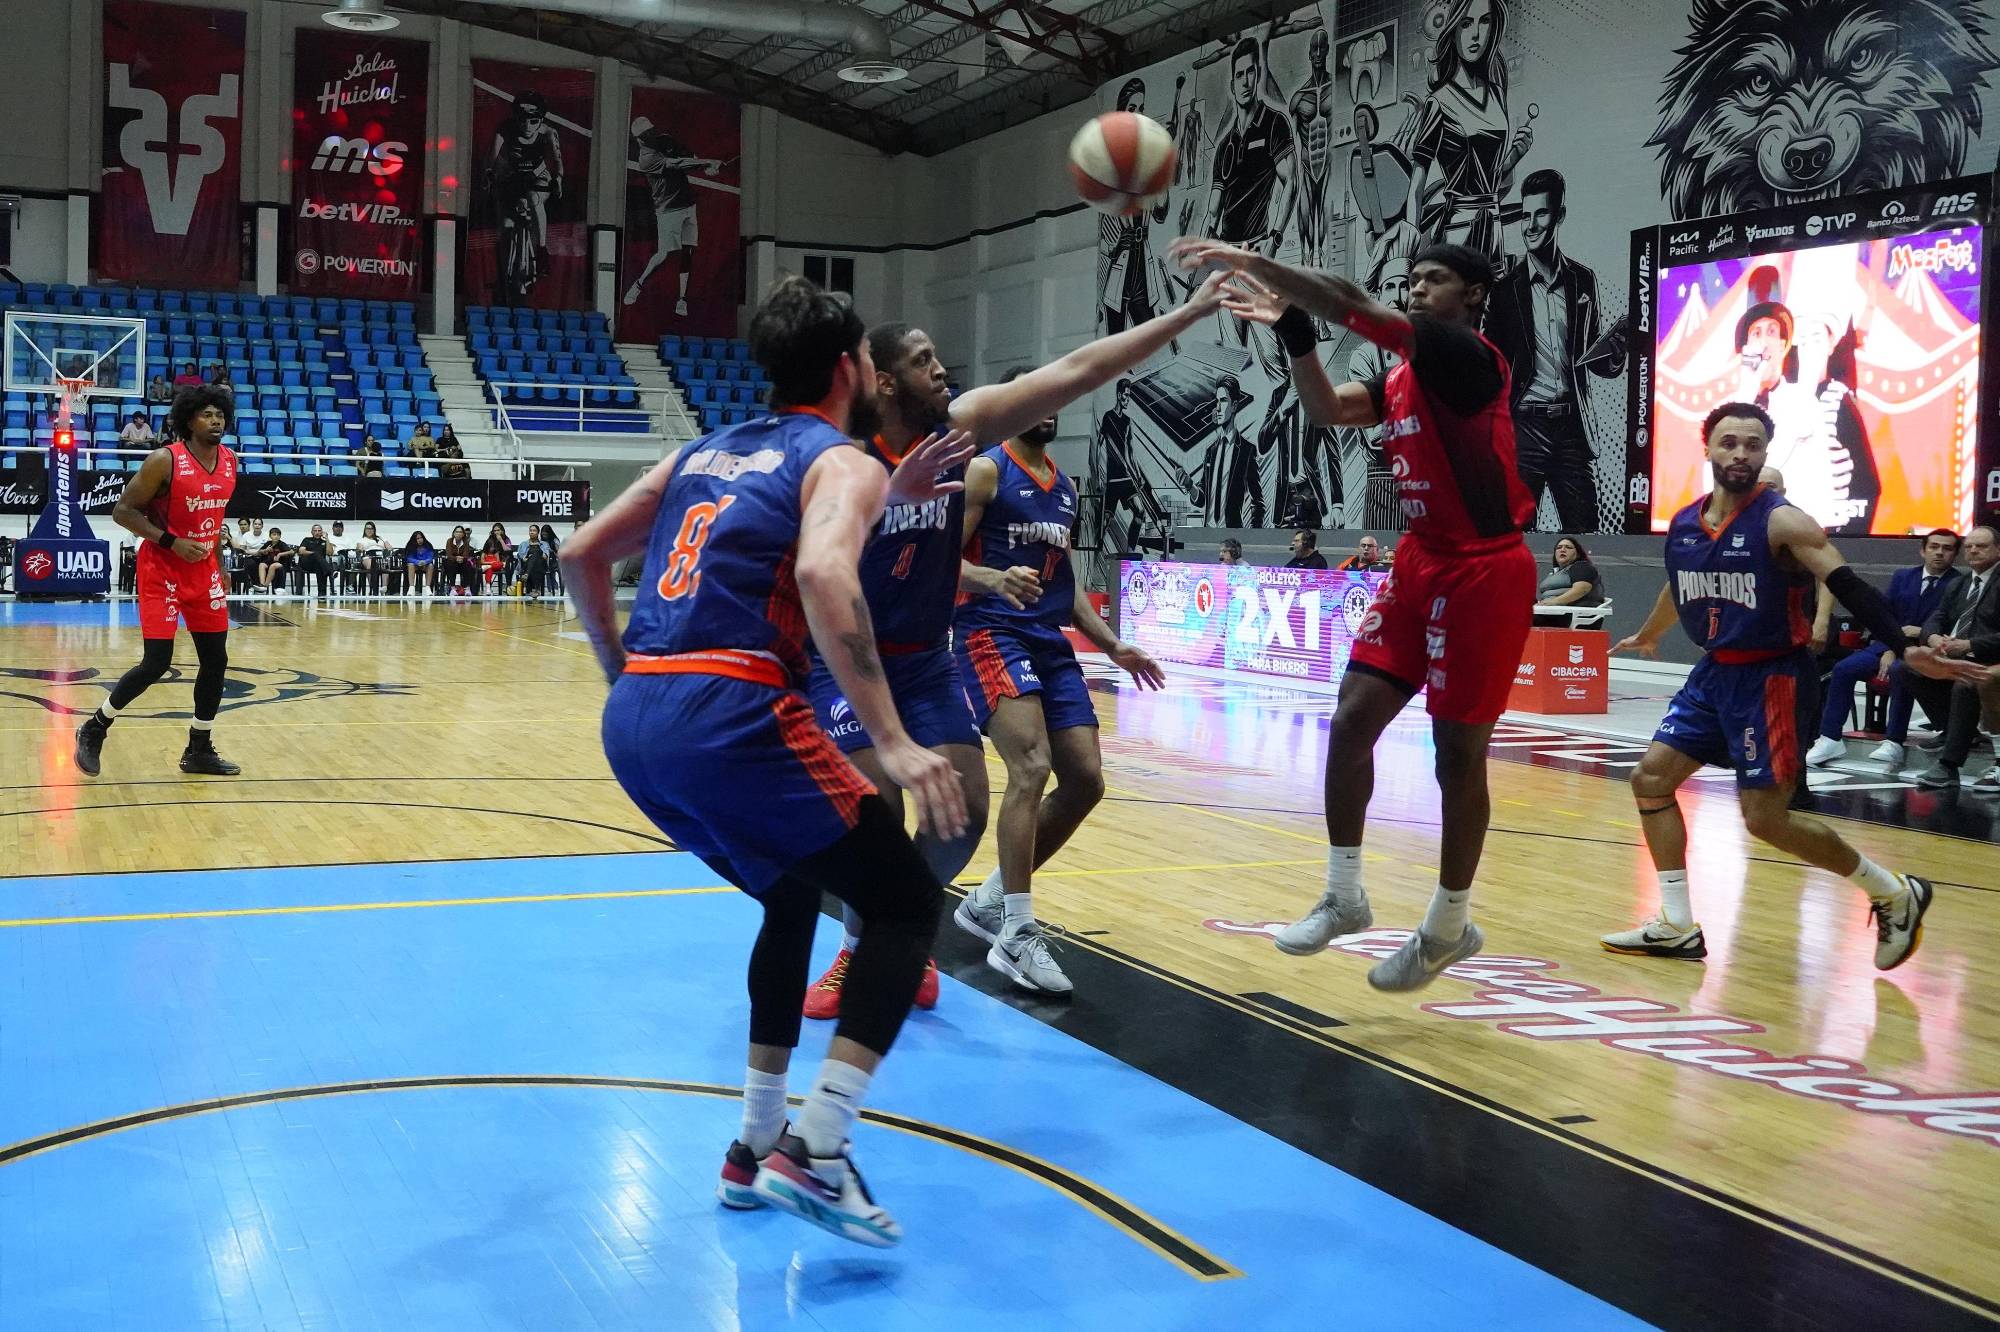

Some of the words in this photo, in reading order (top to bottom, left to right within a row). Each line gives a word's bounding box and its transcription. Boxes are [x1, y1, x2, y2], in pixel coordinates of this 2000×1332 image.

[344, 52, 396, 80] Salsa
[317, 72, 399, 114] Huichol
[311, 135, 409, 175] ms
[300, 198, 415, 226] betVIP.mx
[1931, 192, 1977, 216] ms
[1824, 212, 1857, 232] TVP
[1892, 214, 1920, 225] Azteca
[1669, 244, 1699, 257] Pacific
[93, 474, 125, 492] Salsa
[293, 491, 347, 501] AMERICAN
[306, 500, 347, 509] FITNESS
[410, 491, 482, 510] Chevron
[517, 489, 572, 504] POWER
[541, 503, 572, 517] ADE
[57, 551, 104, 572] UAD
[1677, 570, 1757, 610] PIONEROS
[1660, 722, 1675, 735] GA
[1743, 727, 1757, 761] 5
